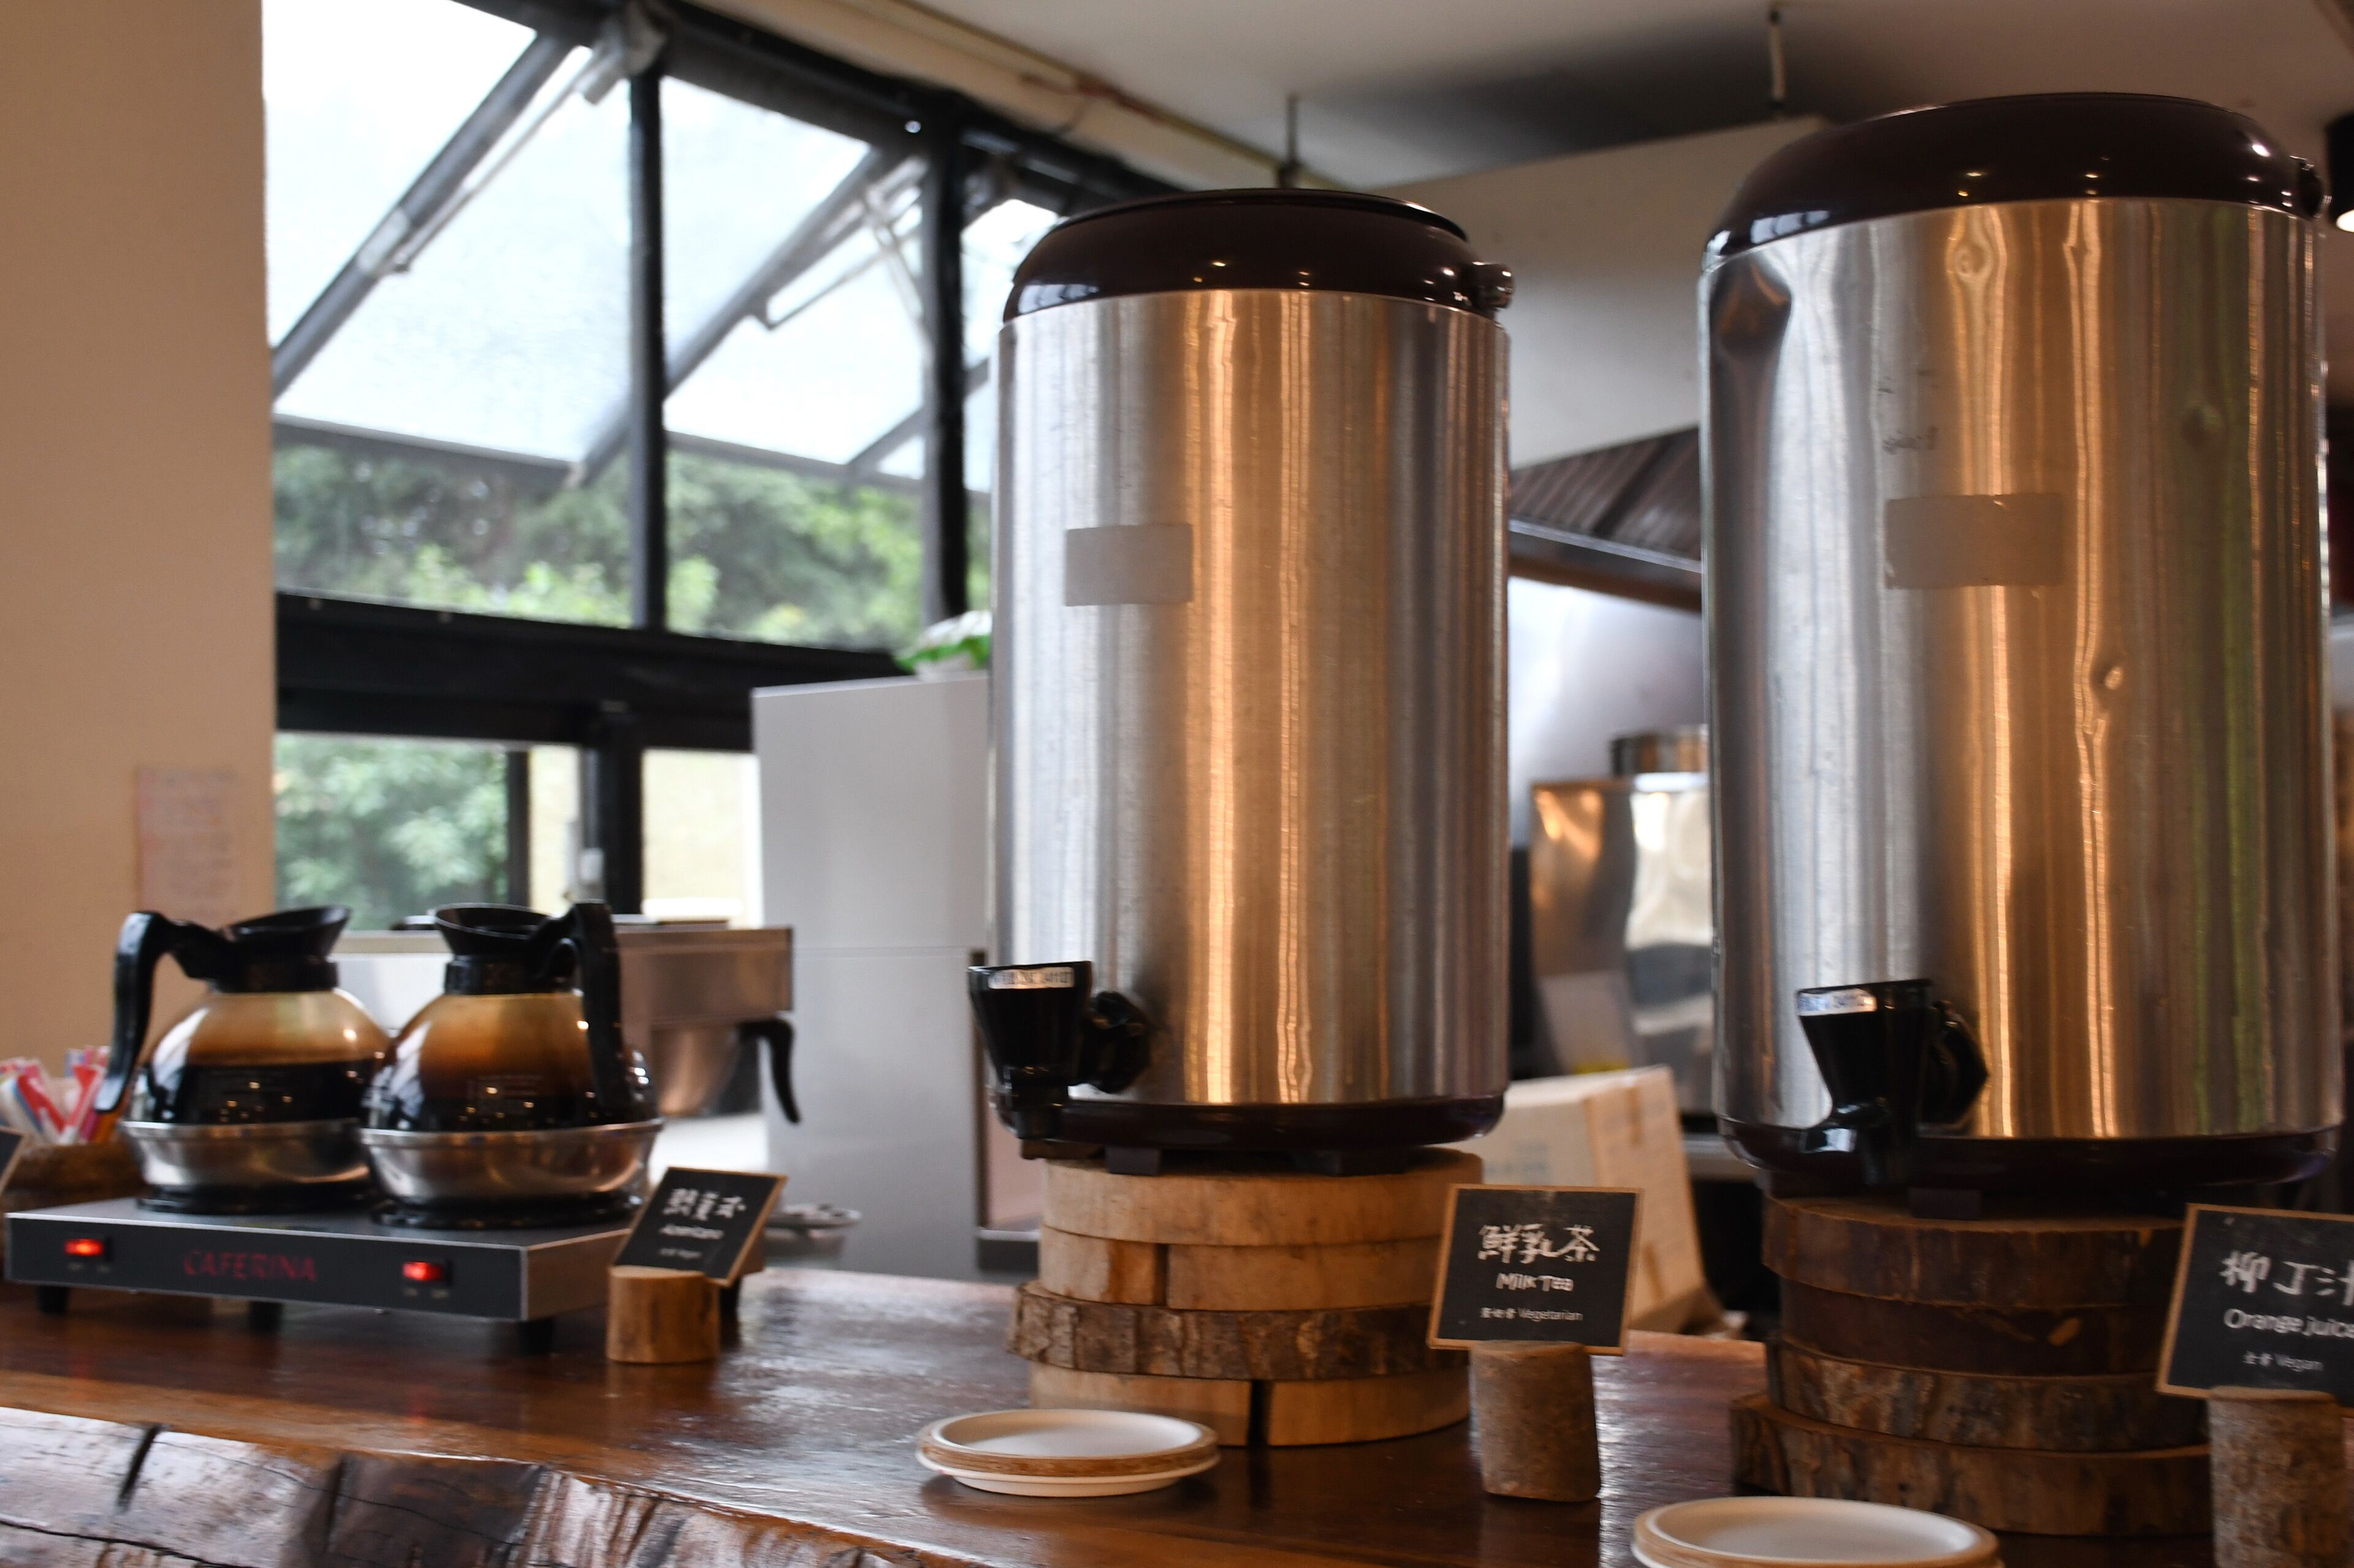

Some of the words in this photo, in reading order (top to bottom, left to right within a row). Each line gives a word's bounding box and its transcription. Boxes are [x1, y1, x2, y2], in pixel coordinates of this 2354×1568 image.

[1477, 1224, 1600, 1264] 鮮乳茶
[2223, 1308, 2304, 1334] Orange
